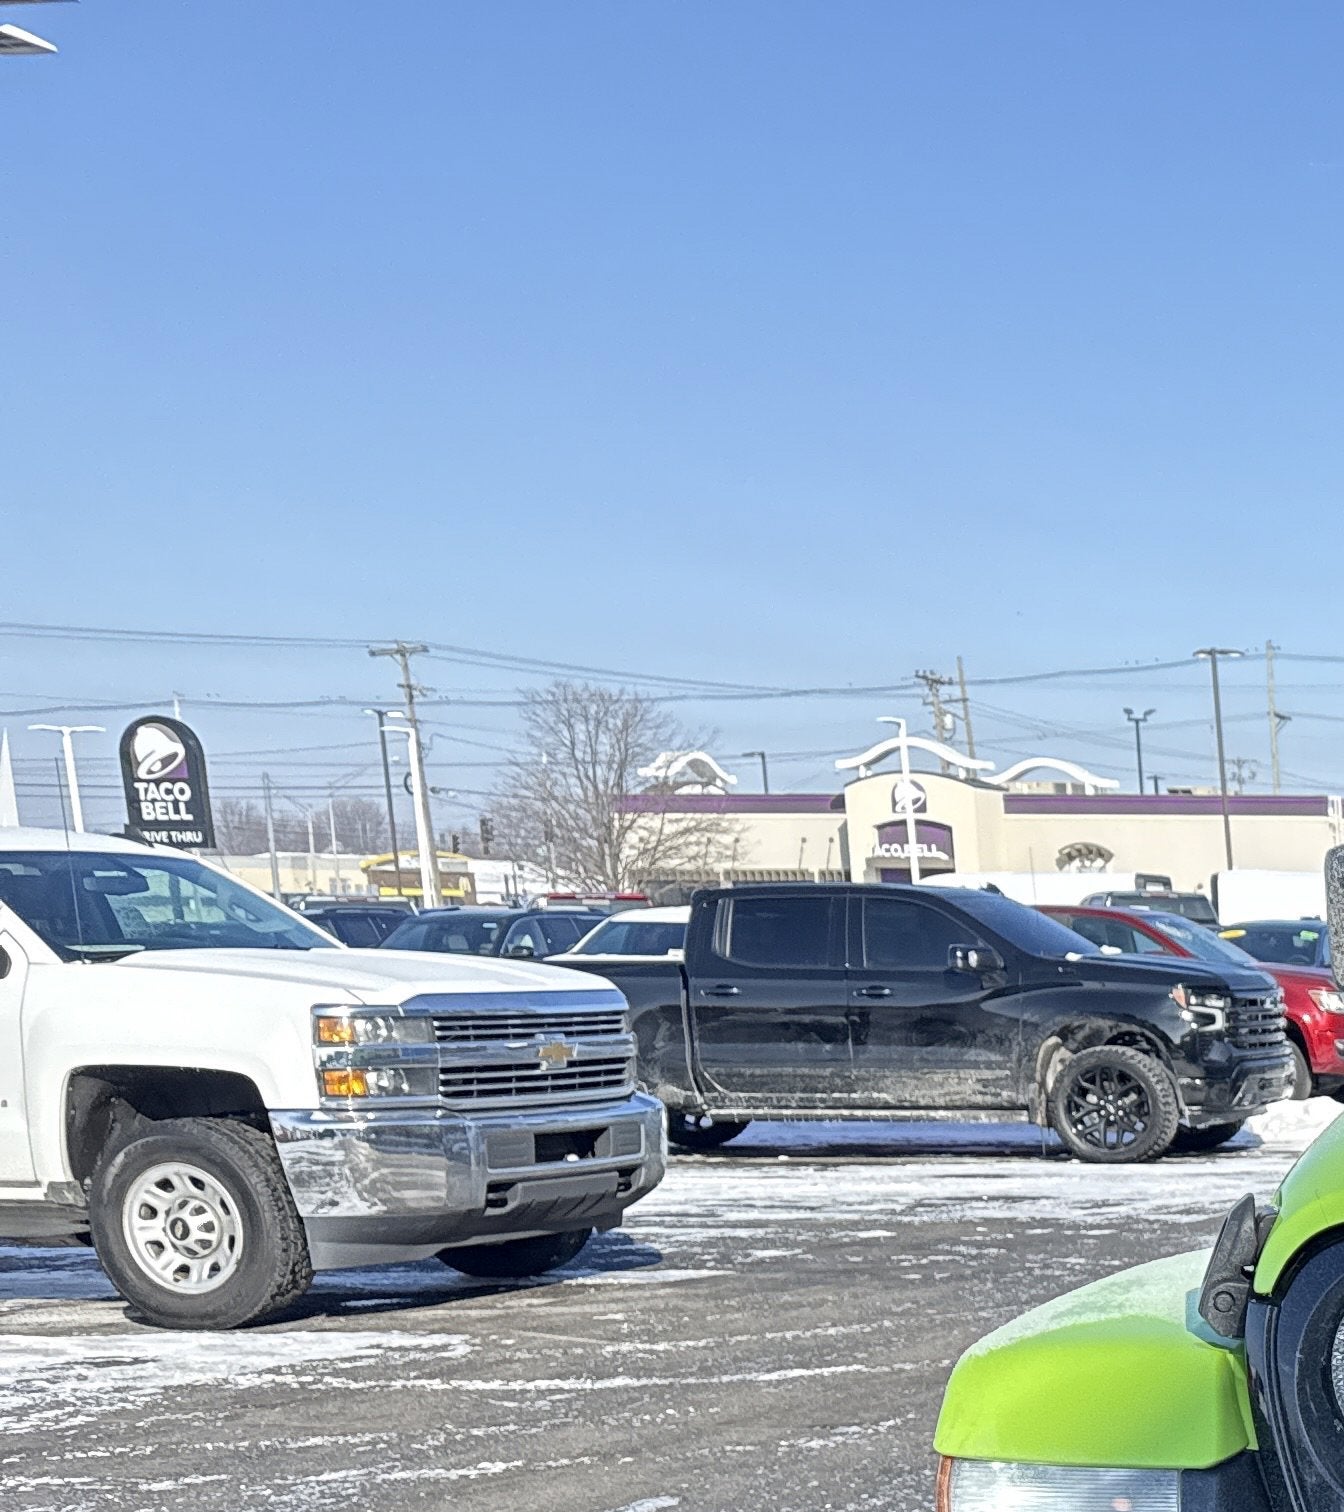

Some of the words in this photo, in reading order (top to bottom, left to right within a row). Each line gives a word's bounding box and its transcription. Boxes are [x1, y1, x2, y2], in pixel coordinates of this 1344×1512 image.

[133, 781, 192, 801] TACO
[140, 801, 194, 821] BELL
[141, 830, 169, 843] RIVE
[169, 830, 203, 844] THRU
[872, 843, 902, 858] ACO
